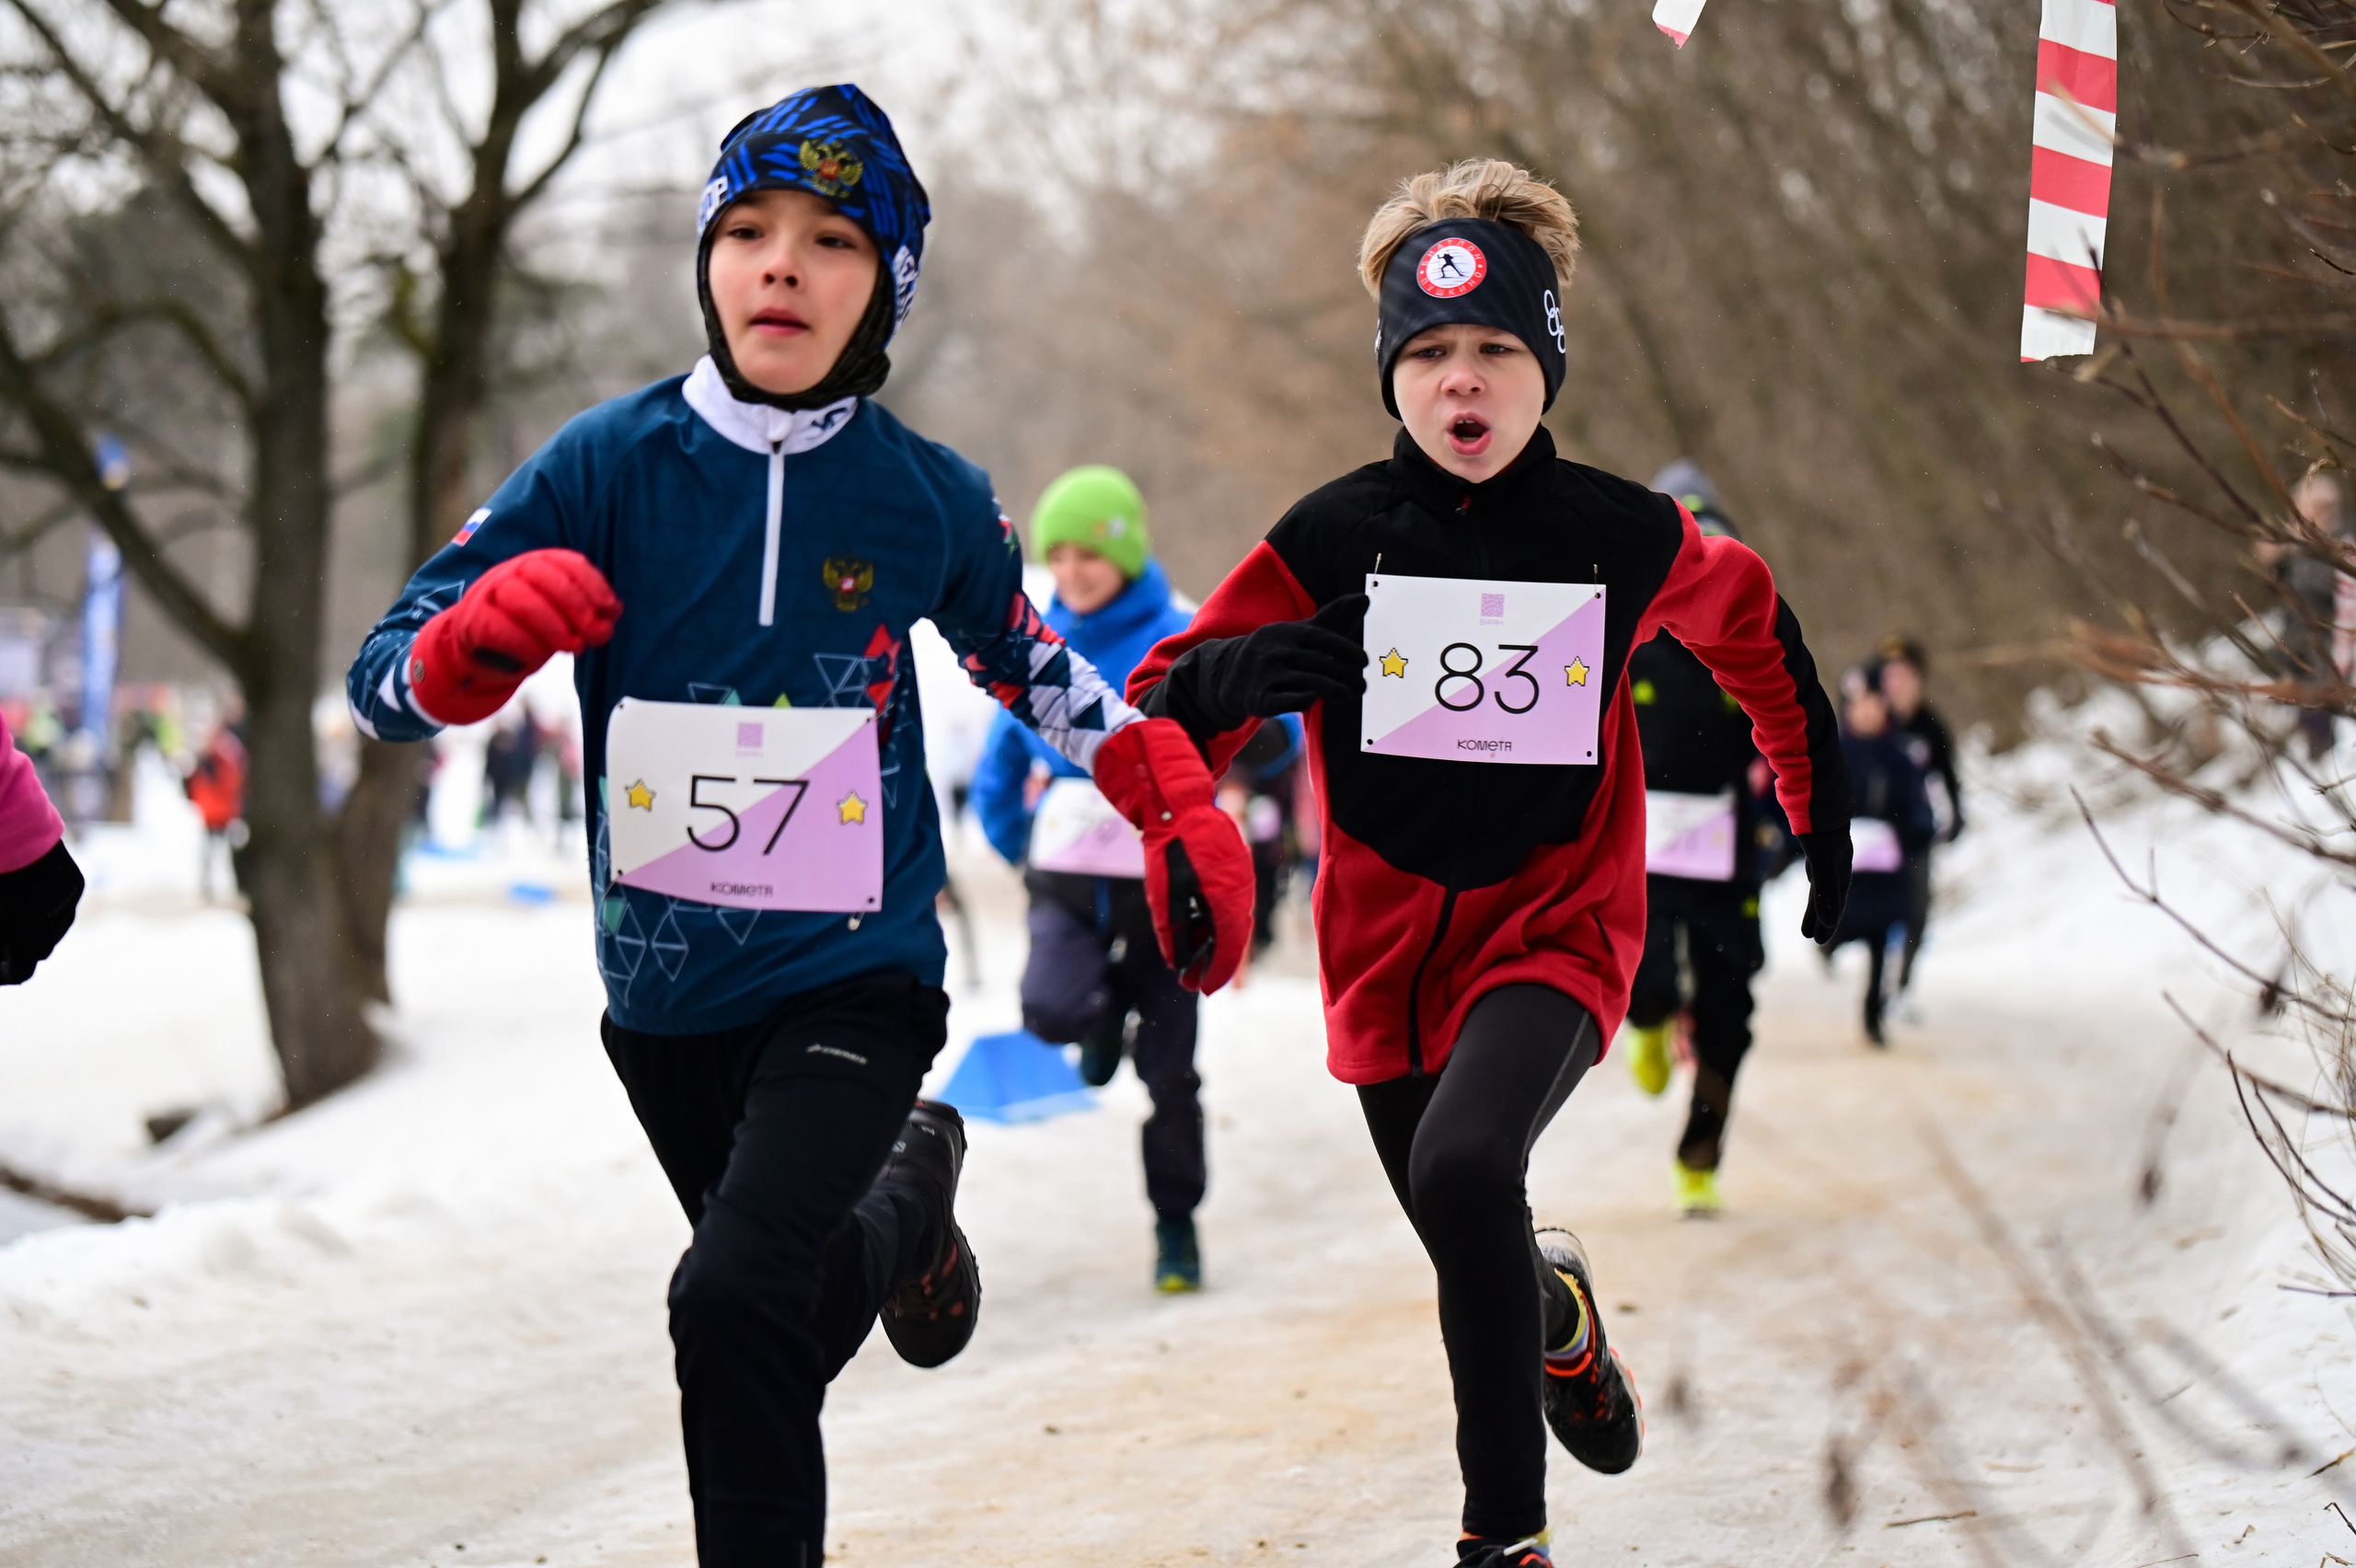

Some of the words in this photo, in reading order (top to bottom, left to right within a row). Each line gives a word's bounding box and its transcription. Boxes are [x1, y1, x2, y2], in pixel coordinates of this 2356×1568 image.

[1421, 239, 1483, 266] БИАТЛОН
[1421, 271, 1483, 296] ПУШКИНО
[1435, 642, 1540, 714] 83
[687, 774, 811, 856] 57
